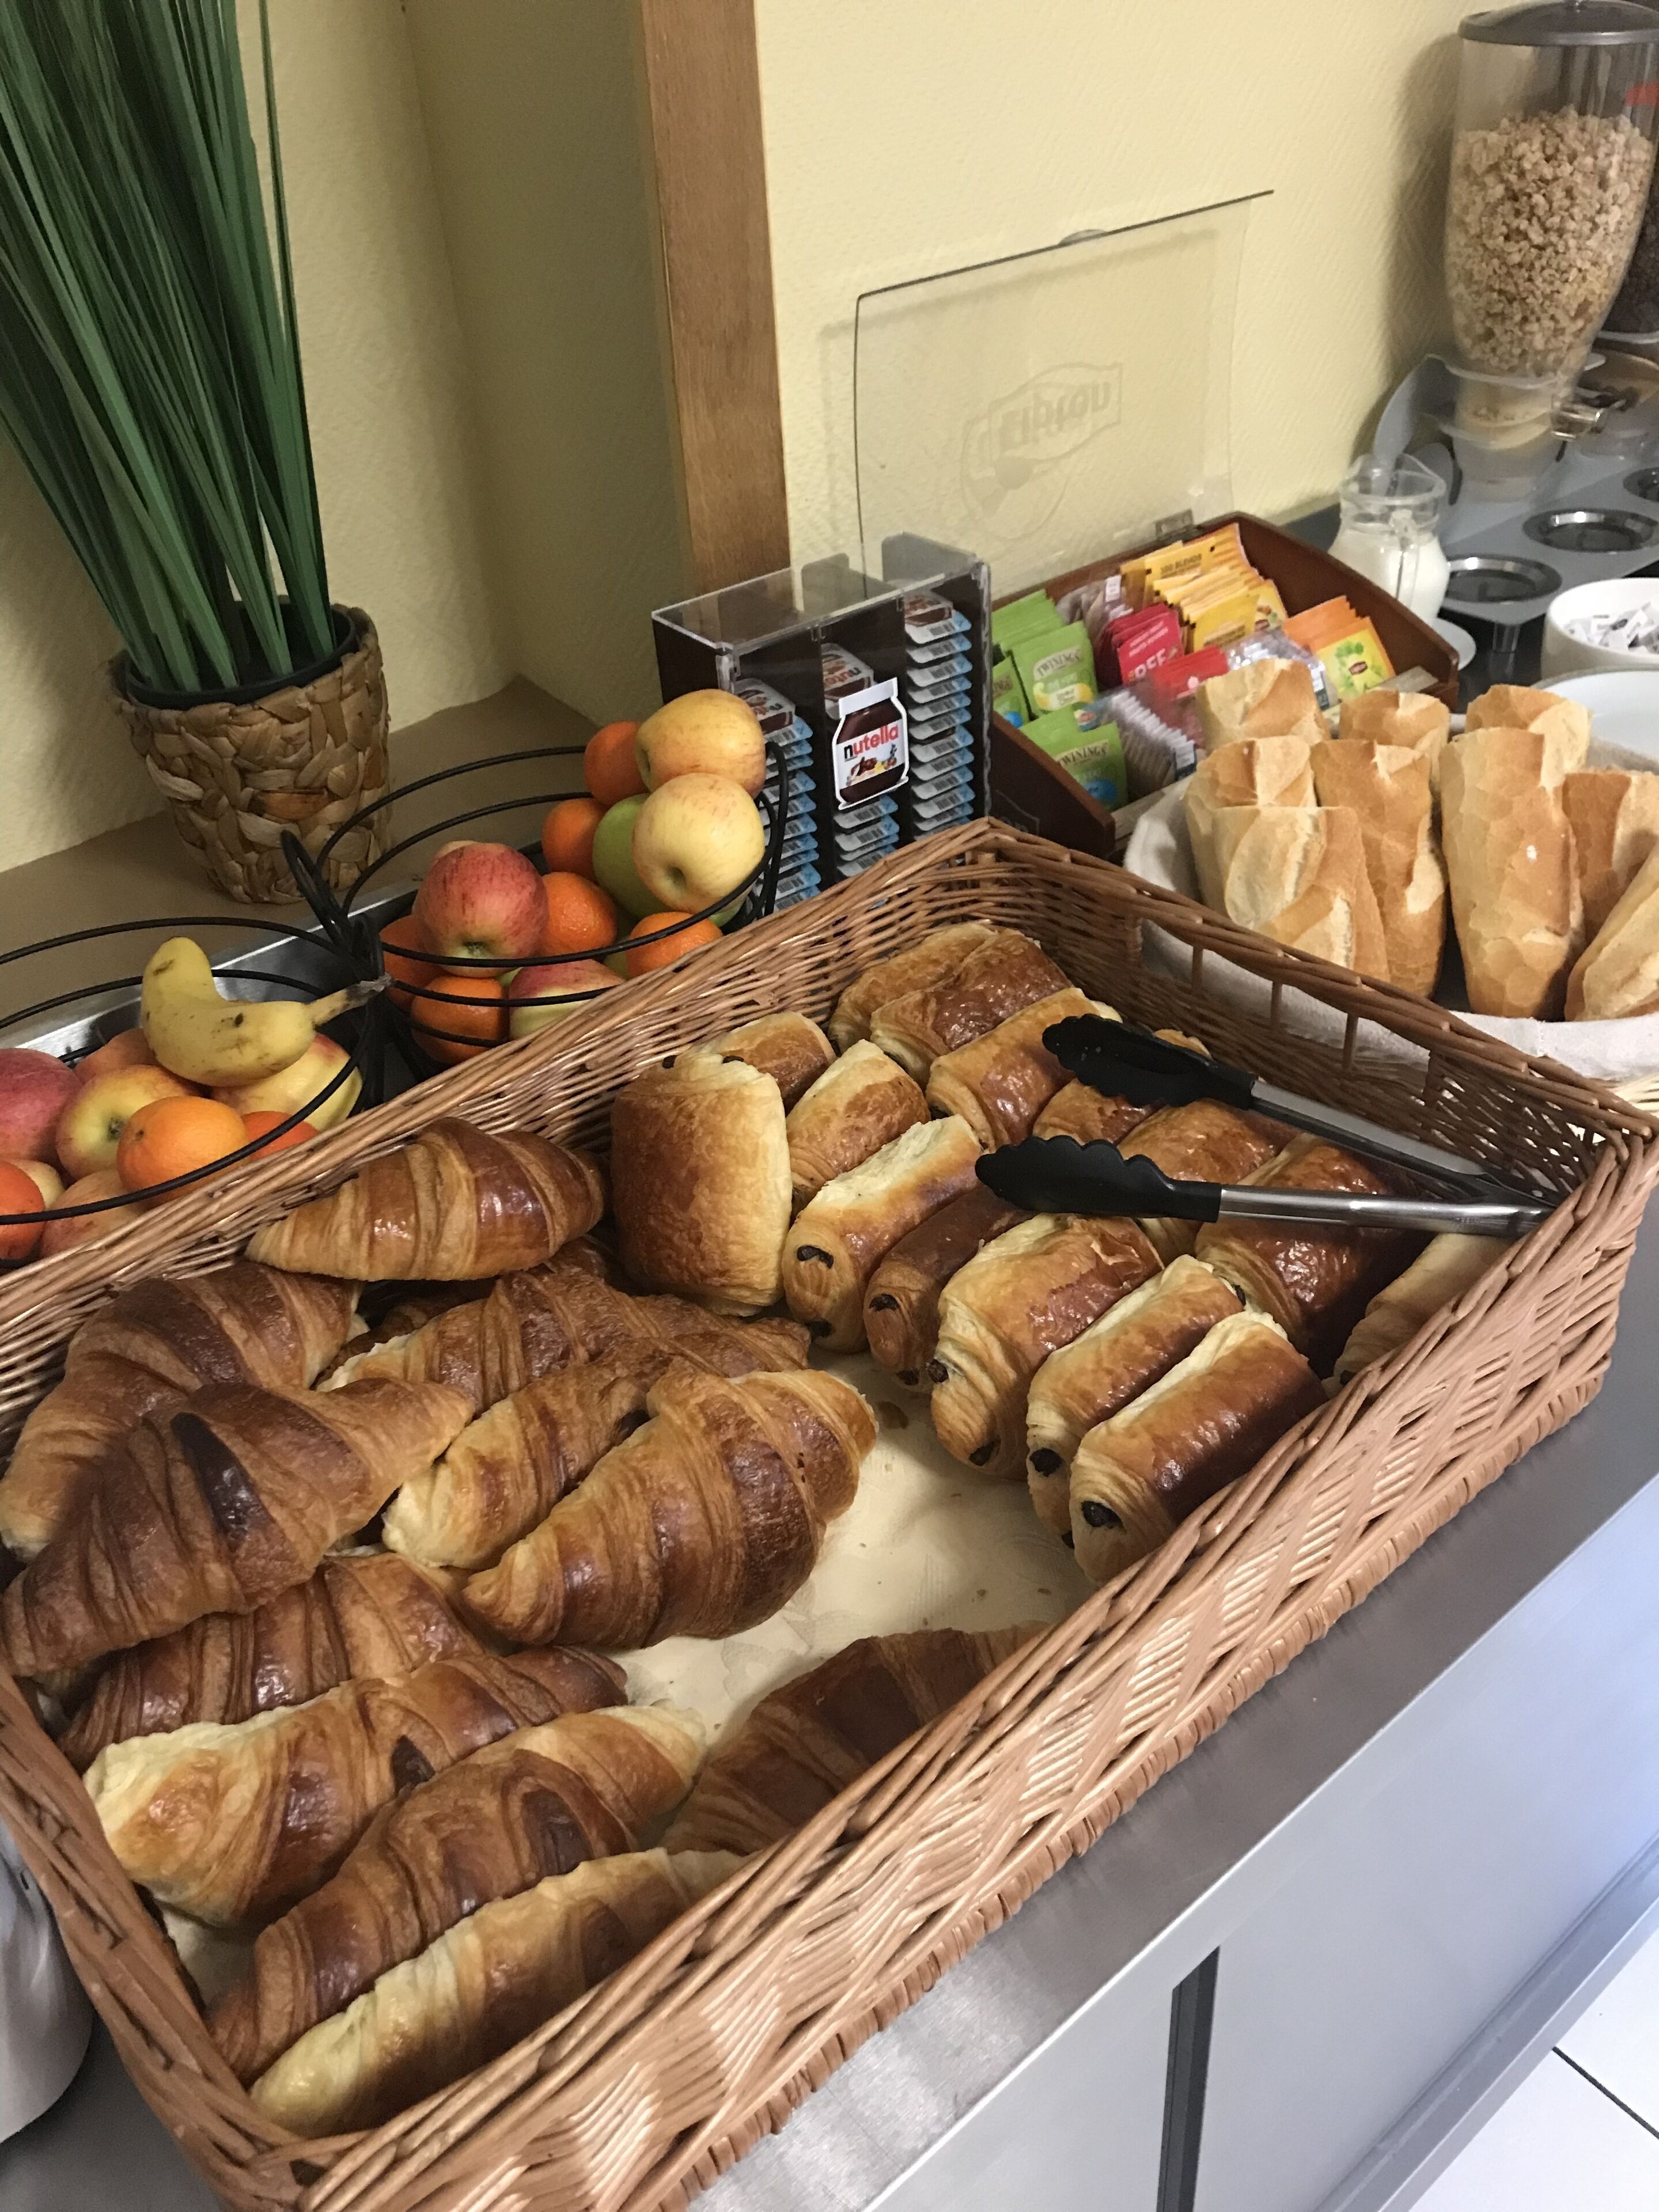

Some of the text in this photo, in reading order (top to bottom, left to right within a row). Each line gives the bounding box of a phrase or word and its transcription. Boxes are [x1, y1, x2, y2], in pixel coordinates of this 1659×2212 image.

[1037, 649, 1080, 676] TWININGS
[844, 725, 899, 759] nutella
[1056, 741, 1108, 765] WININGS
